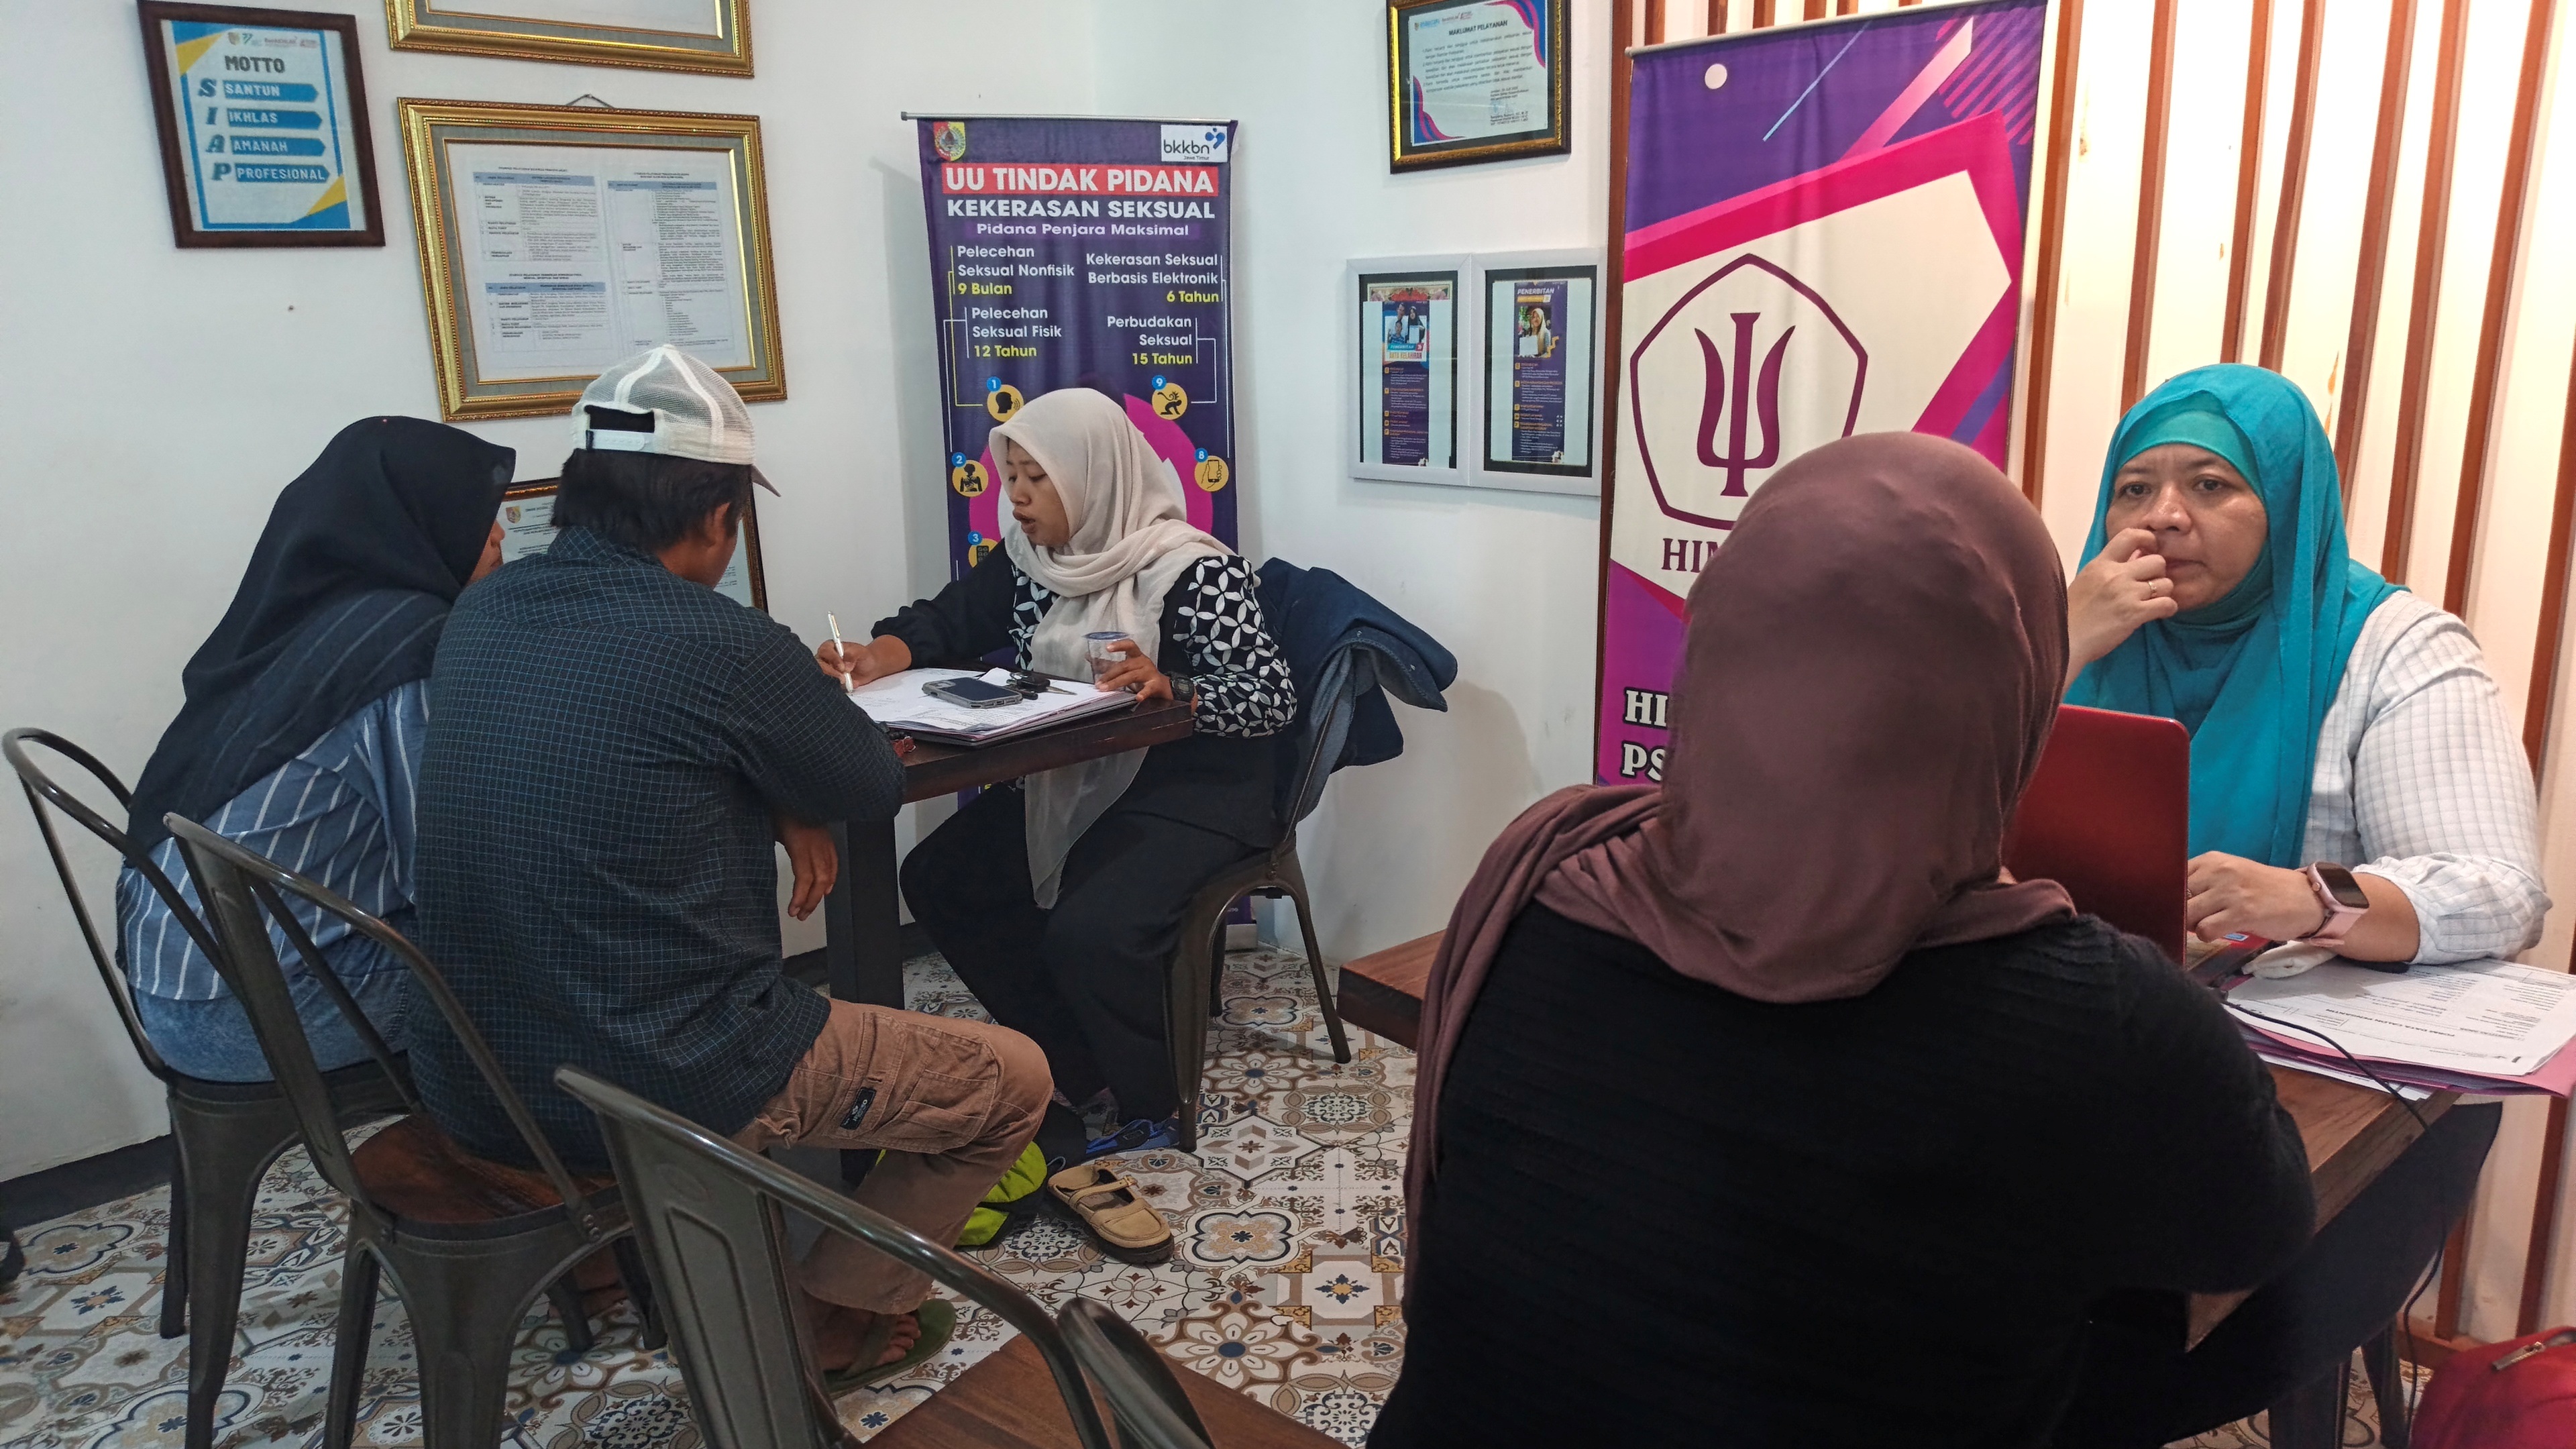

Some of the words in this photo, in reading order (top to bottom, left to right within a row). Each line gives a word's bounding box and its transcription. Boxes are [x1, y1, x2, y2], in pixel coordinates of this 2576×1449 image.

[1449, 25, 1477, 36] MAKLUMAT
[1477, 20, 1508, 31] PELAYANAN
[224, 55, 286, 74] MOTTO
[198, 78, 217, 97] S
[224, 83, 280, 98] SANTUN
[205, 107, 218, 125] I
[229, 111, 278, 124] IKHLAS
[205, 134, 225, 154] A
[233, 140, 288, 153] AMANAH
[1163, 139, 1210, 154] bkkbn
[211, 162, 232, 181] P
[237, 168, 326, 181] PROFESIONAL
[946, 167, 985, 191] UU
[992, 168, 1099, 192] TINDAK
[1107, 168, 1214, 193] PIDANA
[947, 199, 1100, 218] KEKERASAN
[1108, 201, 1216, 219] SEKSUAL
[977, 223, 1036, 235] Pidana
[1042, 224, 1106, 237] Penjara
[1111, 224, 1189, 236] Maksimal
[957, 246, 1035, 258] Pelecehan
[1086, 253, 1161, 266] Kekerasan
[1165, 254, 1218, 266] Seksual
[958, 264, 1014, 277] Seksual
[1018, 264, 1075, 277] Nonfisik
[1087, 272, 1148, 285] Berbasis
[1152, 272, 1218, 285] Elektronik
[957, 283, 967, 295] 9
[971, 283, 1012, 295] Bulan
[1166, 290, 1175, 303] 6
[1178, 290, 1219, 303] Tahun
[971, 307, 1049, 320] Pelecehan
[1107, 315, 1192, 329] Perbudakan
[972, 325, 1028, 338] Seksual
[1032, 325, 1062, 338] Fisik
[1139, 334, 1192, 347] Seksual
[974, 345, 991, 358] 12
[994, 345, 1037, 358] Tahun
[1132, 352, 1148, 365] 15
[1152, 352, 1193, 366] Tahun
[991, 380, 998, 389] 1
[1156, 378, 1163, 387] 9
[956, 455, 963, 465] 2
[1197, 451, 1205, 460] 8
[972, 534, 979, 543] 3
